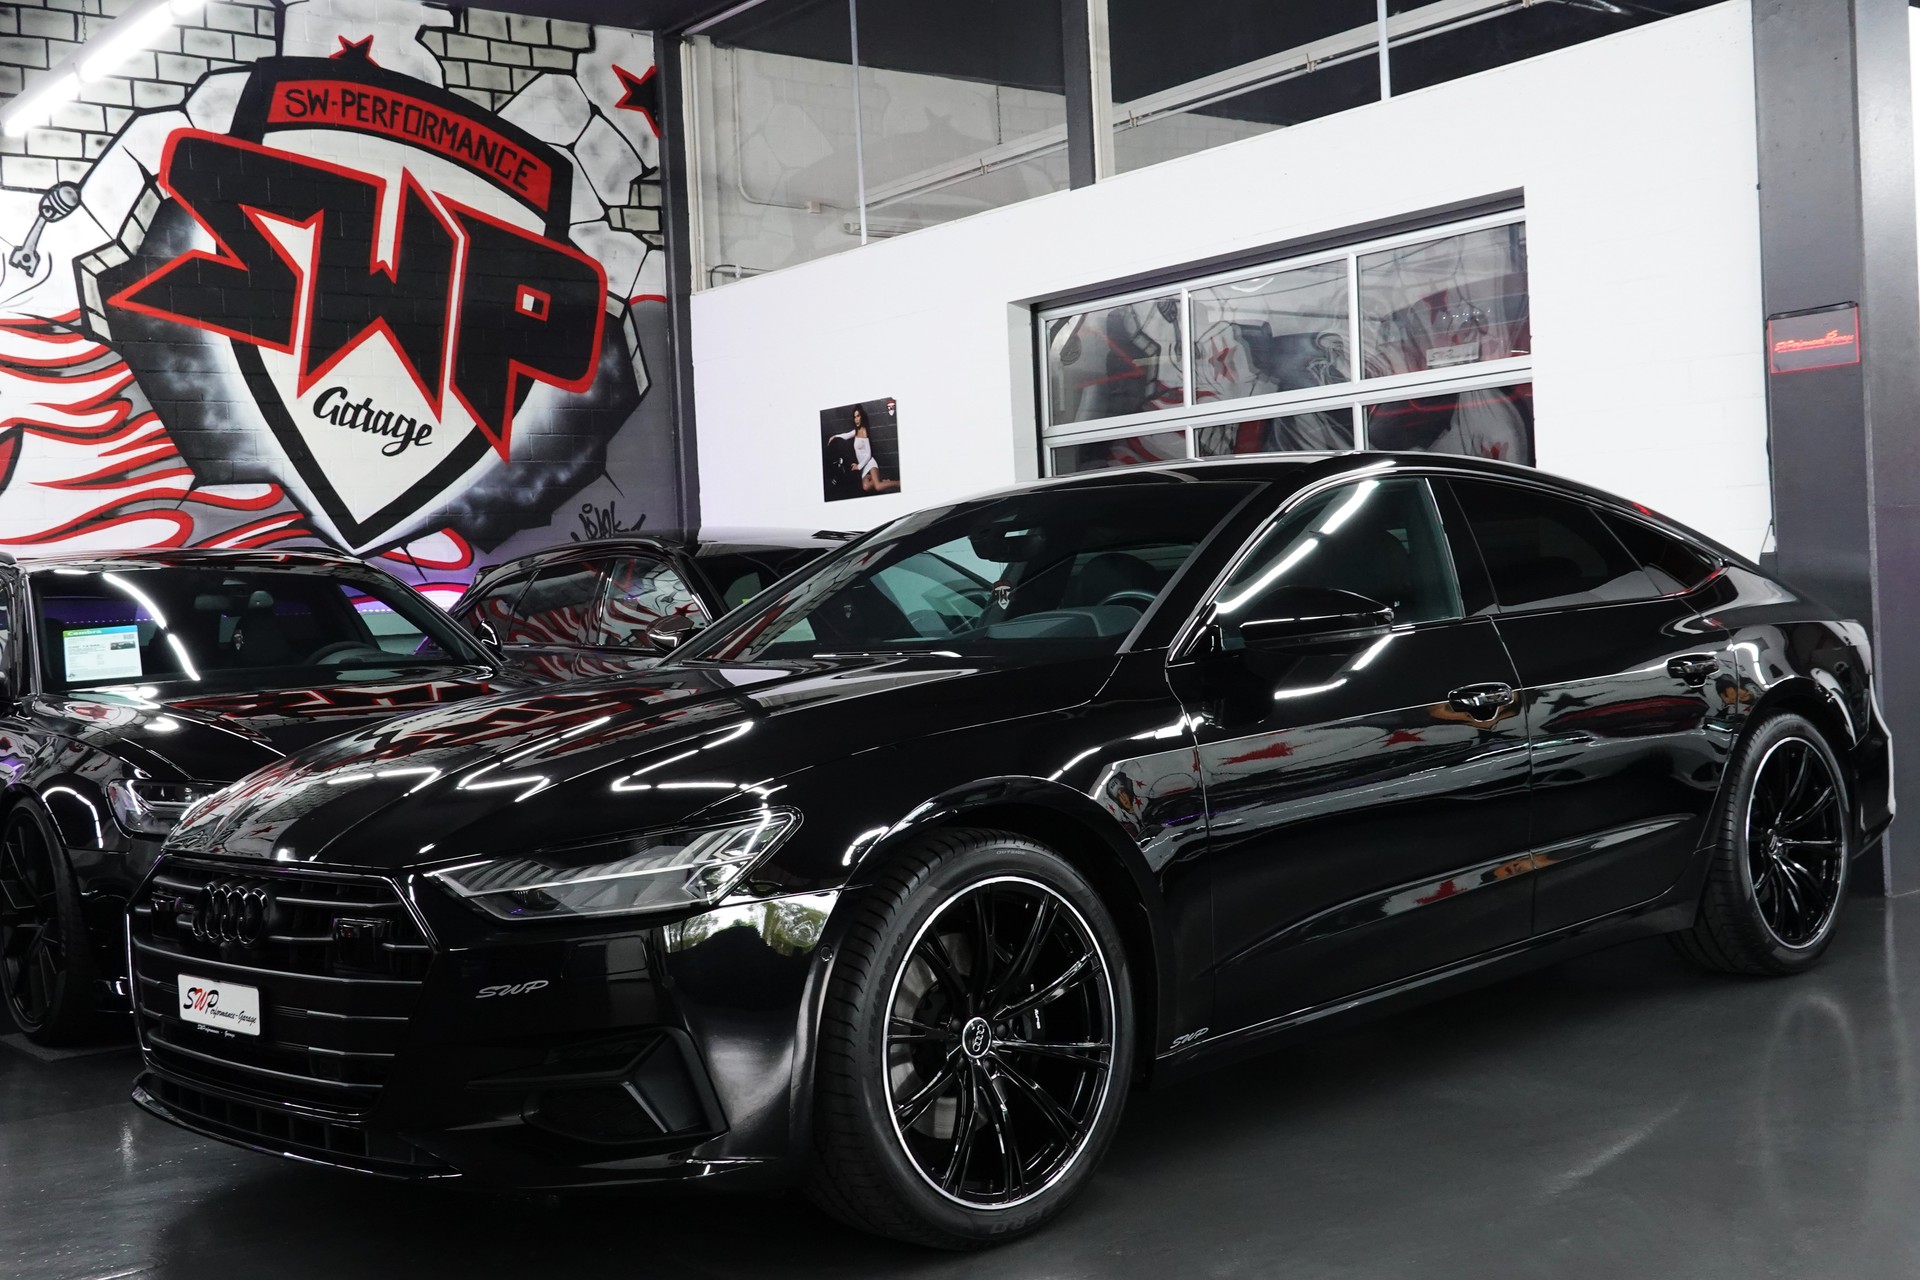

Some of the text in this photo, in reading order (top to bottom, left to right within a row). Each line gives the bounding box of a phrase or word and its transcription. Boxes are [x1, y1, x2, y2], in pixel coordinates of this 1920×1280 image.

[284, 88, 538, 192] SW-PERFORMANCE
[106, 126, 608, 464] SWP
[312, 386, 433, 457] Garage
[475, 979, 549, 999] SWP
